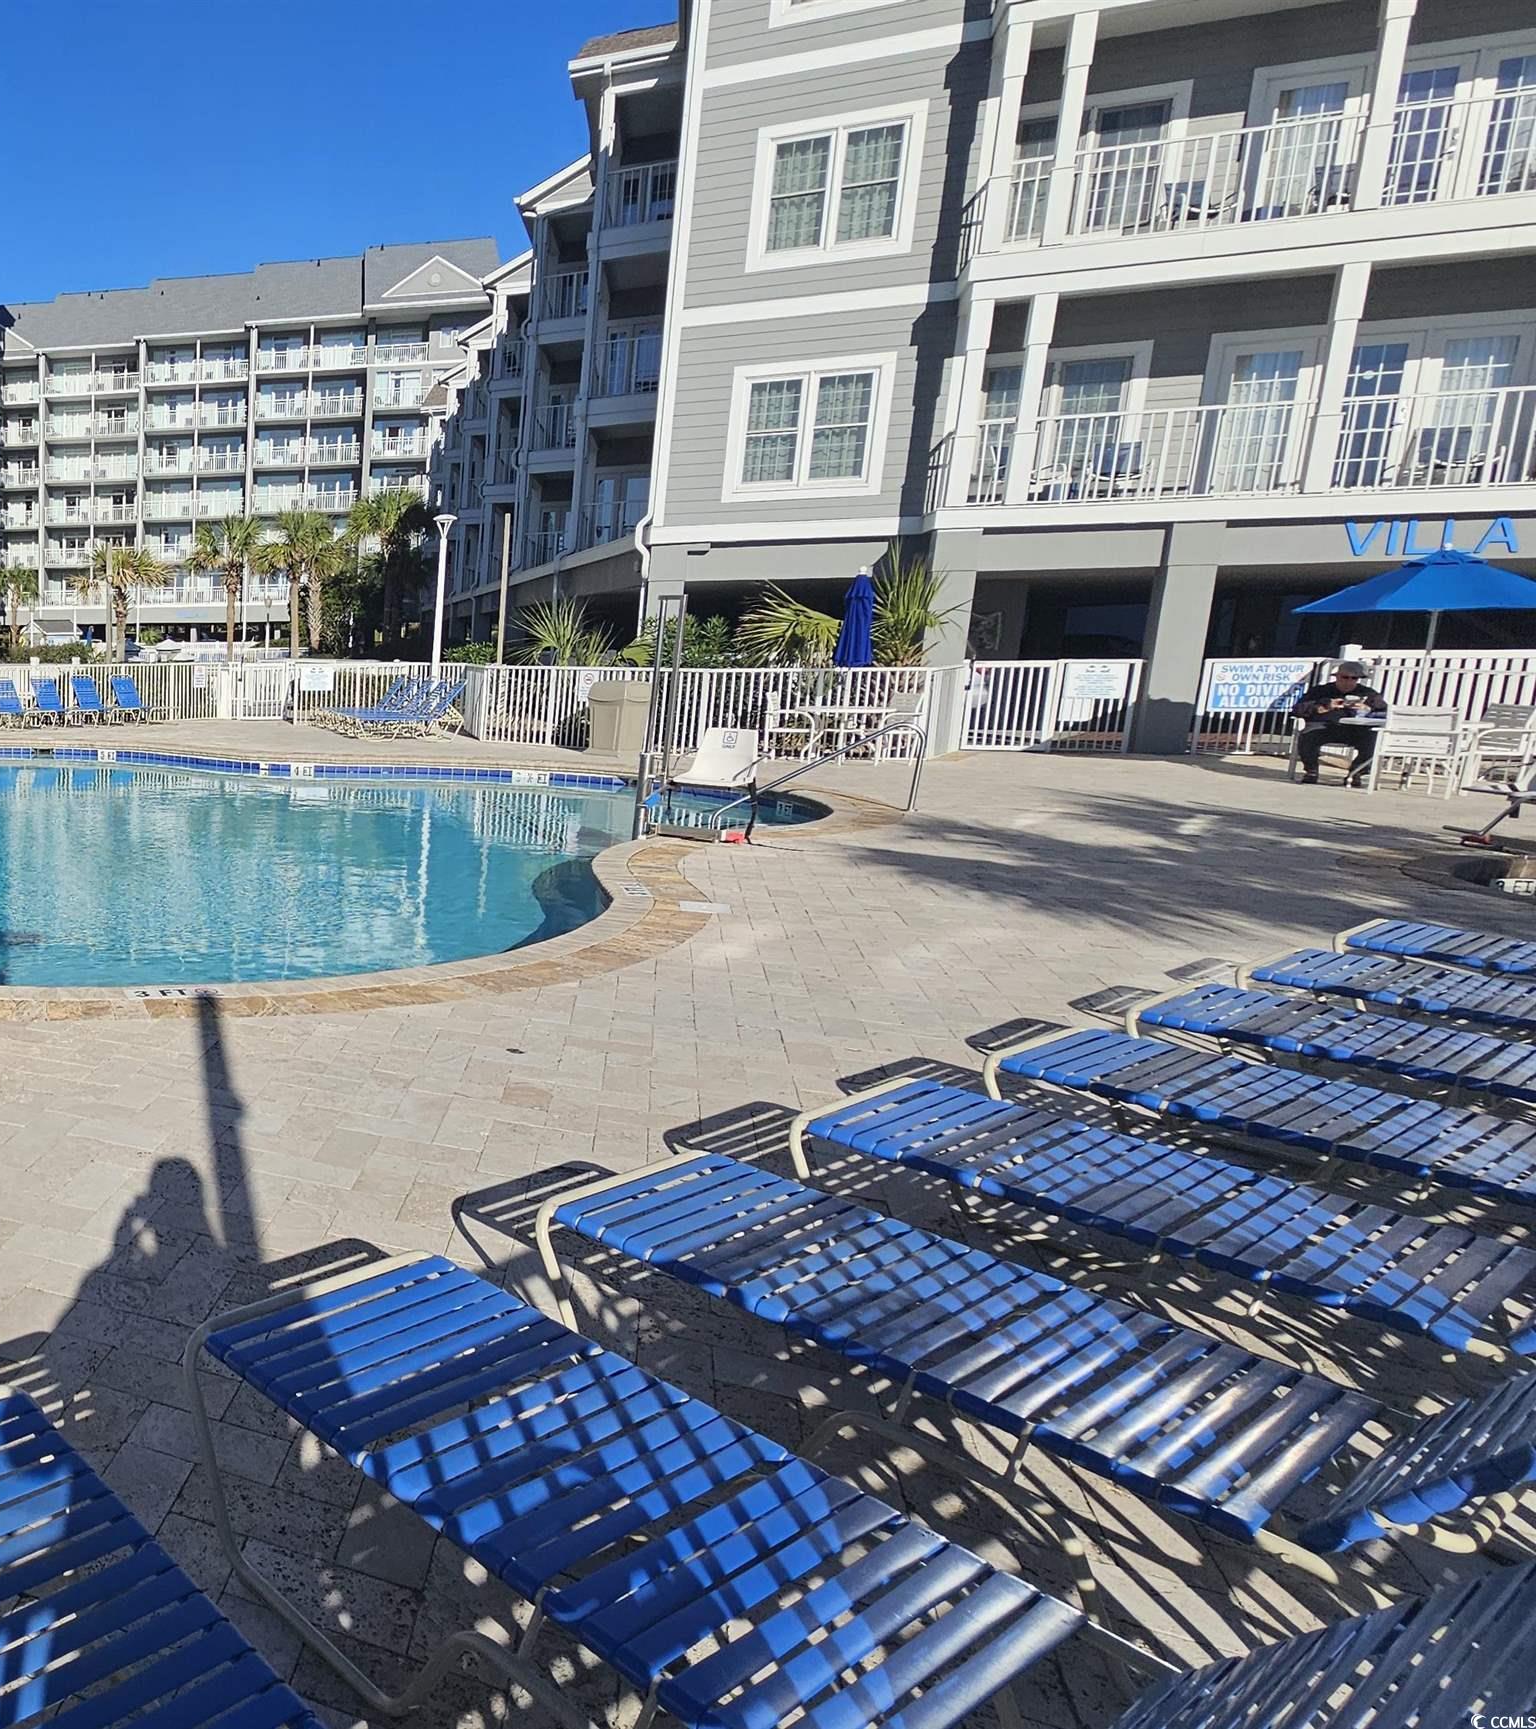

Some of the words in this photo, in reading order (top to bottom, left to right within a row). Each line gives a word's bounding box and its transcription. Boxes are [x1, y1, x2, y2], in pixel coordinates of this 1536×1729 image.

[1344, 518, 1520, 556] VILLA
[1221, 664, 1254, 673] SWIM
[1256, 664, 1270, 672] AT
[1274, 664, 1305, 672] YOUR
[1232, 673, 1260, 681] OWN
[1263, 673, 1291, 681] RISK
[1217, 684, 1240, 696] NO
[1244, 684, 1300, 696] DIVING
[1218, 696, 1294, 708] ALLOWED
[134, 990, 150, 998] 3
[159, 988, 187, 997] FT
